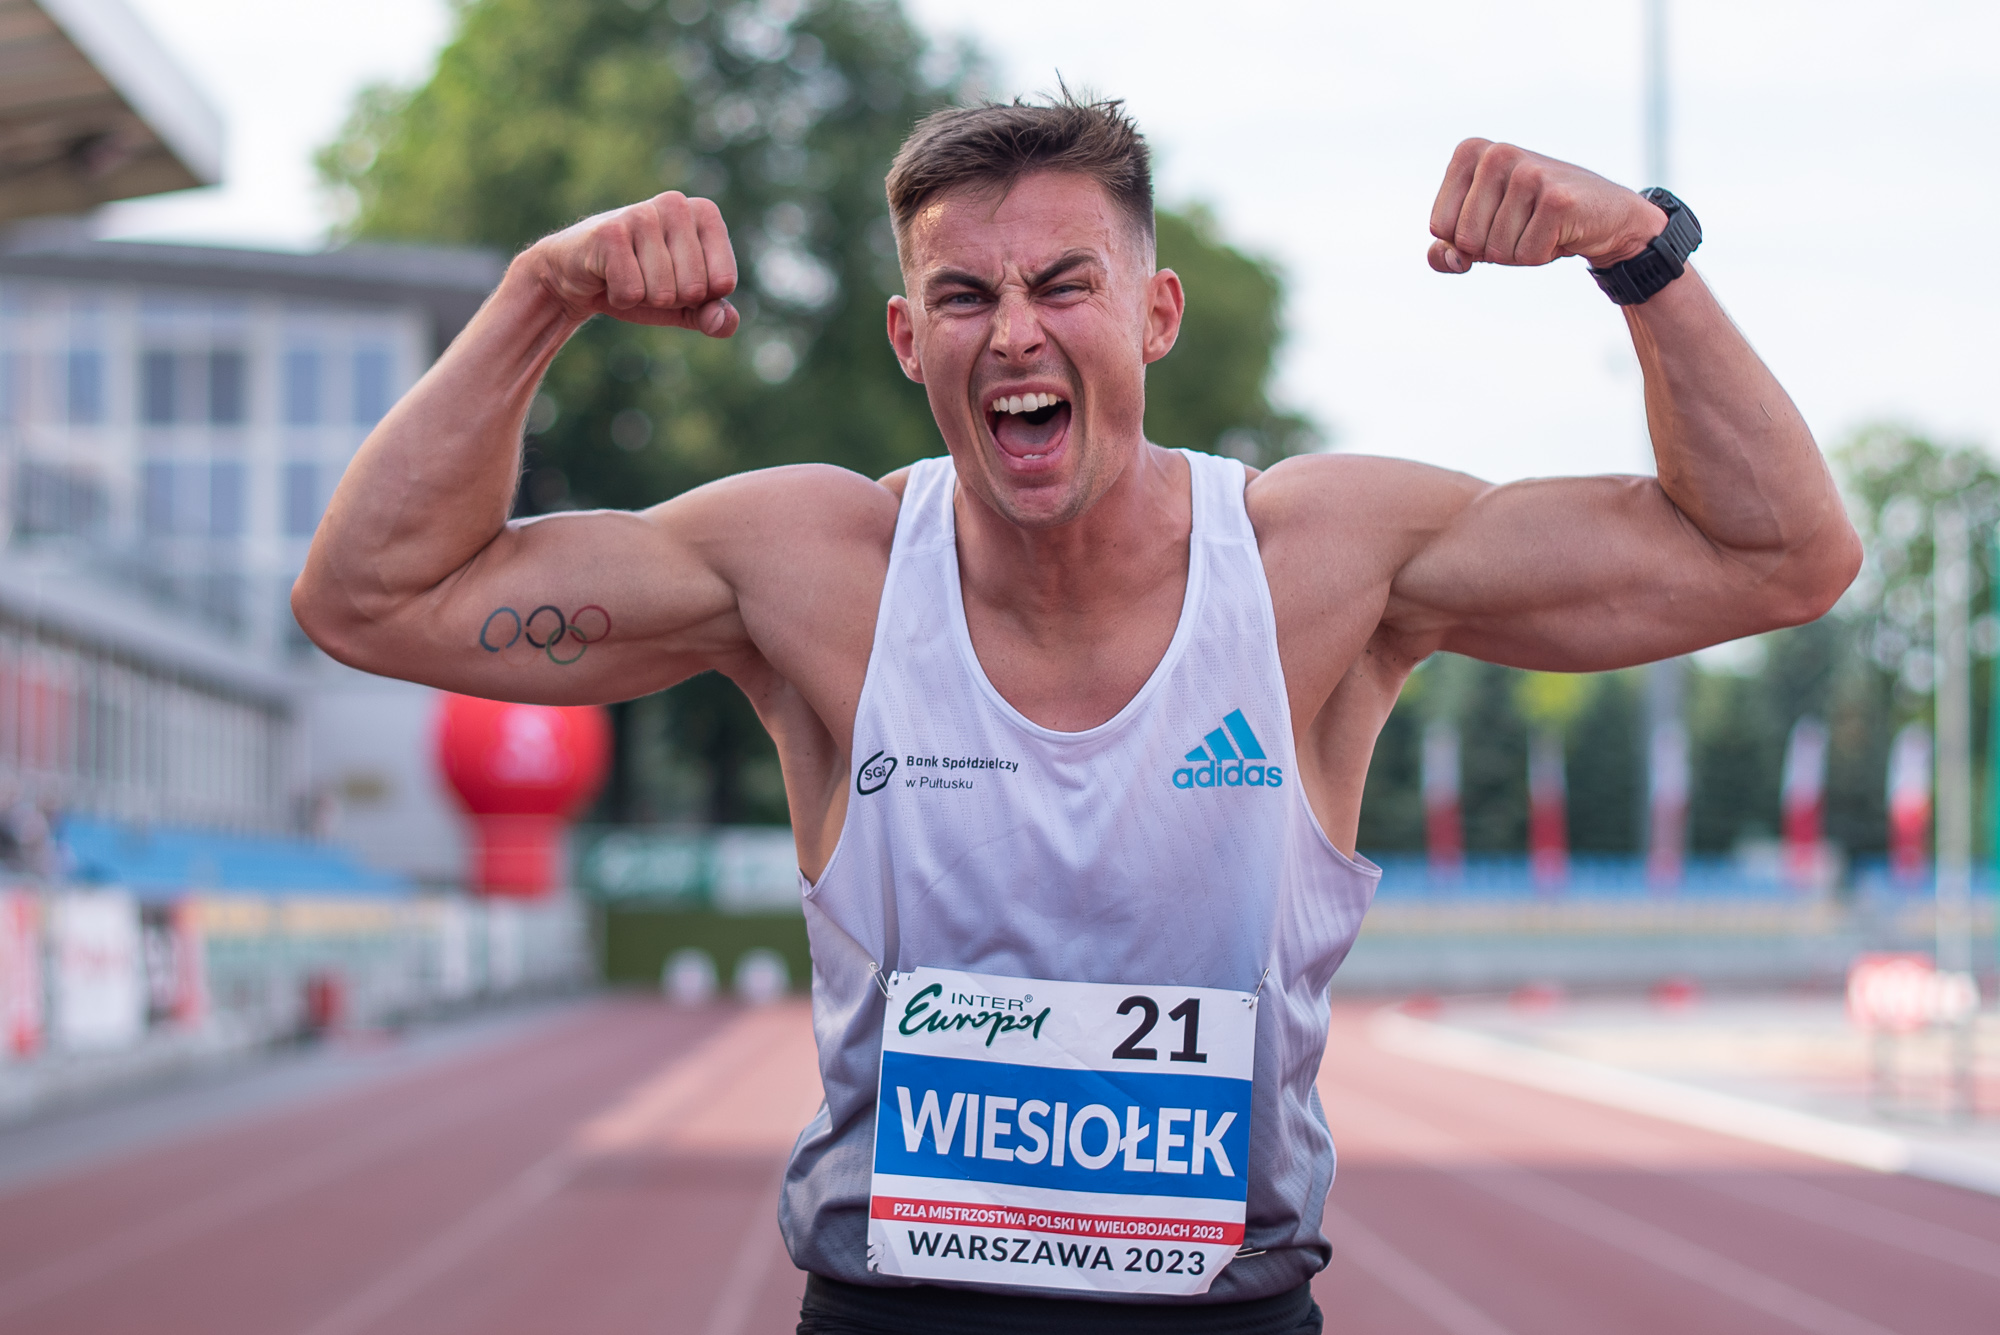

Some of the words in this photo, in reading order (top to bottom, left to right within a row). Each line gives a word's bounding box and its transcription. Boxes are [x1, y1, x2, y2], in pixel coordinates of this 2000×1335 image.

[905, 779, 916, 788] w
[920, 776, 974, 789] Pułtusku
[906, 755, 939, 768] Bank
[942, 756, 1019, 772] Spółdzielczy
[1171, 759, 1283, 790] adidas
[898, 982, 1051, 1047] Europol
[1112, 994, 1208, 1064] 21
[896, 1085, 1238, 1177] WIESIOŁEK
[893, 1202, 927, 1218] PZLA
[929, 1205, 1027, 1226] MISTRZOSTWA
[1028, 1213, 1075, 1230] POLSKI
[1077, 1218, 1092, 1232] W
[1094, 1219, 1190, 1238] WIELOBOJACH
[1192, 1225, 1224, 1240] 2023
[907, 1230, 1115, 1271] WARSZAWA
[1124, 1247, 1206, 1276] 2023
